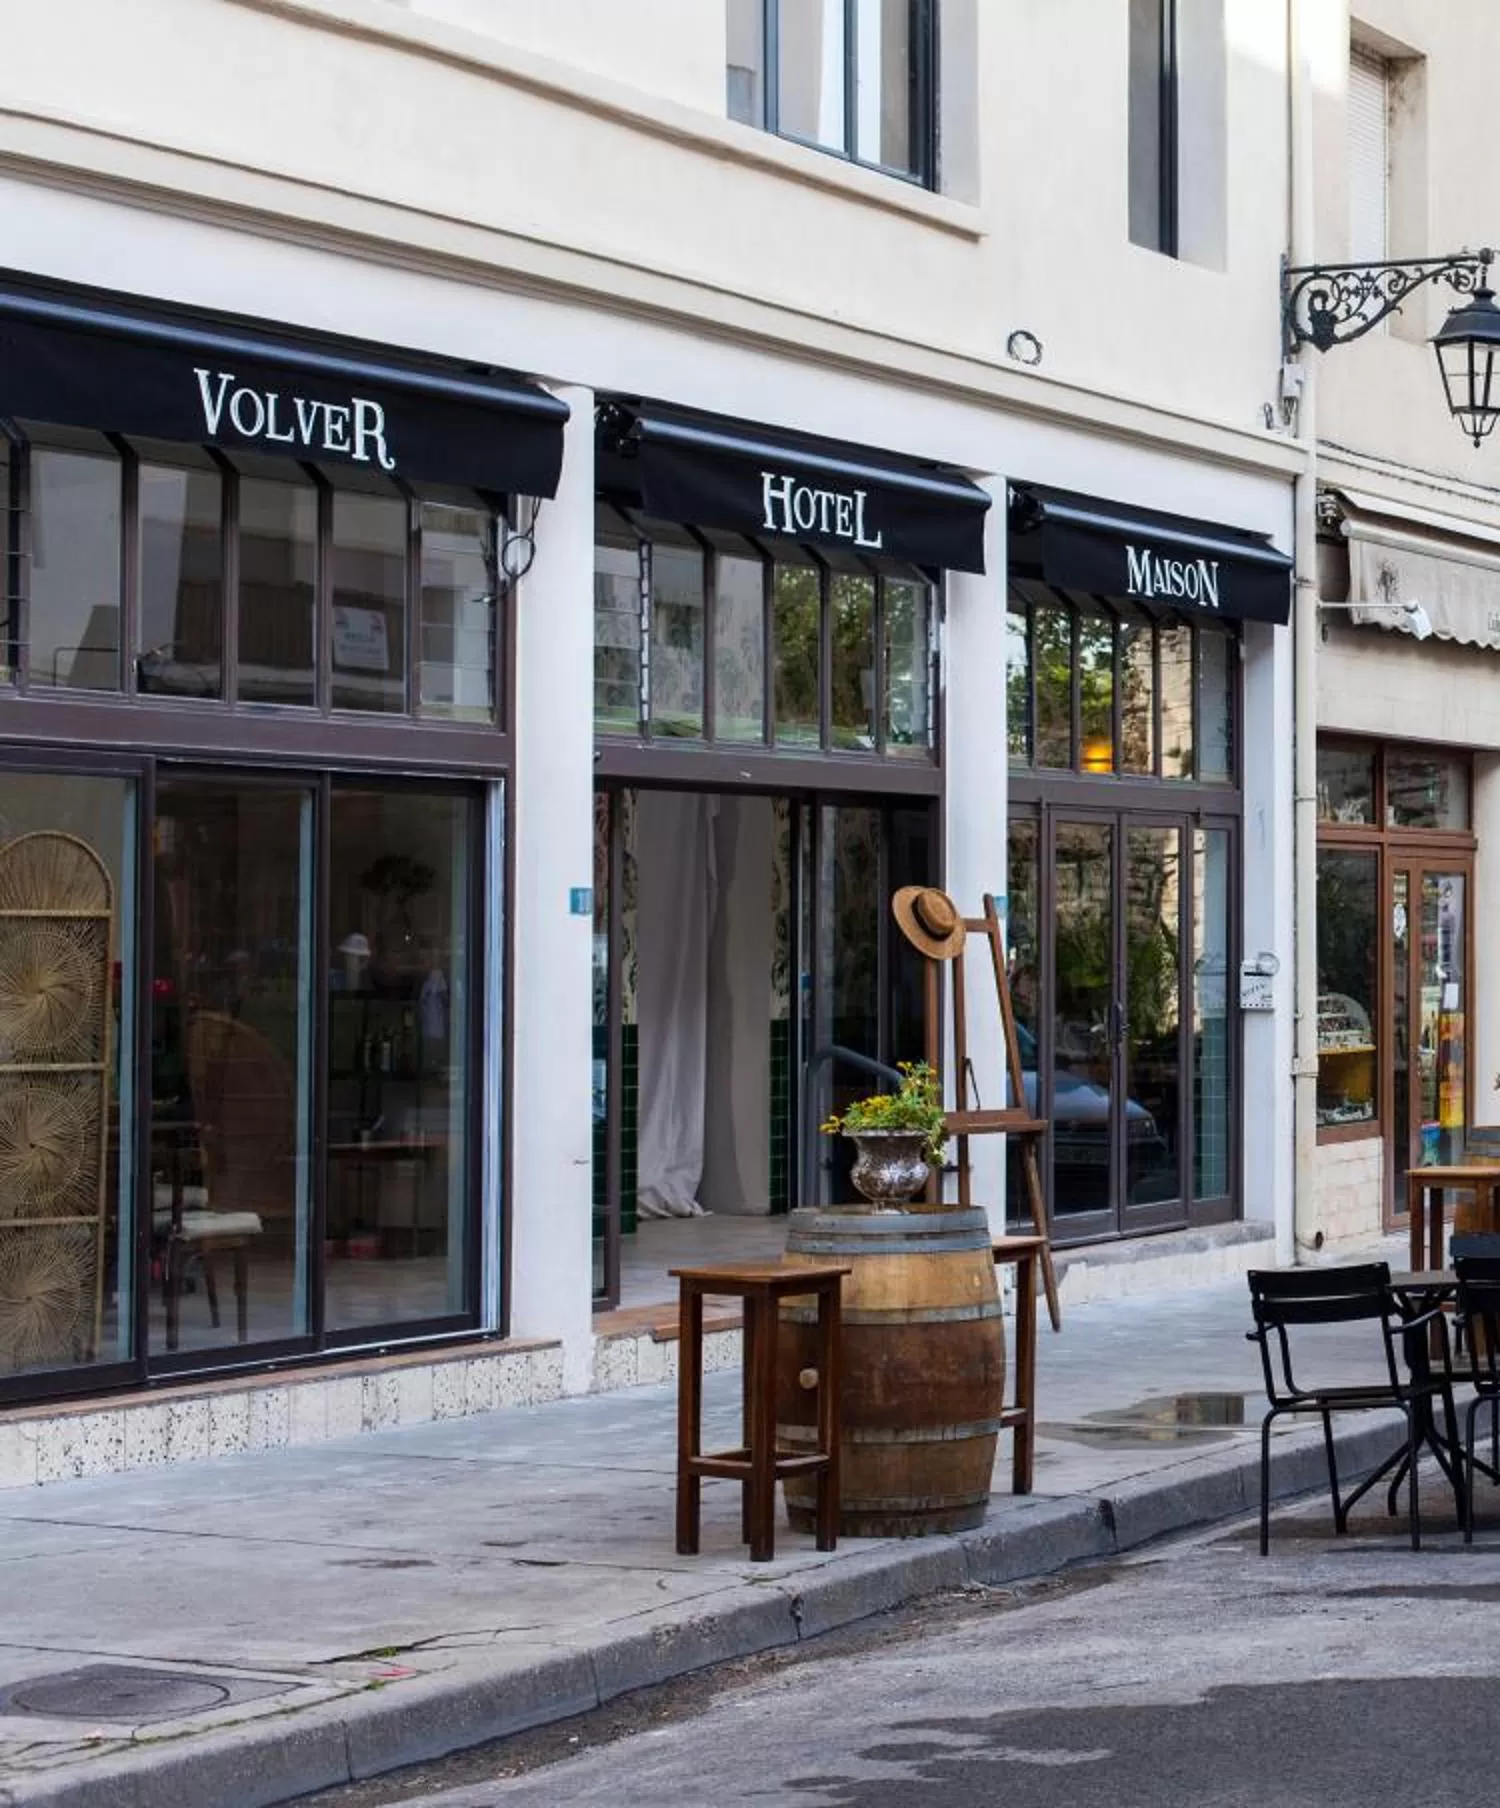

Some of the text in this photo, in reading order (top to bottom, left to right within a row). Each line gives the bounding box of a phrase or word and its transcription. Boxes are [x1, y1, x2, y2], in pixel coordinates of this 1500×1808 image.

[194, 367, 396, 470] VOLVER
[761, 471, 882, 549] HOTEL
[1125, 545, 1219, 608] MAISON
